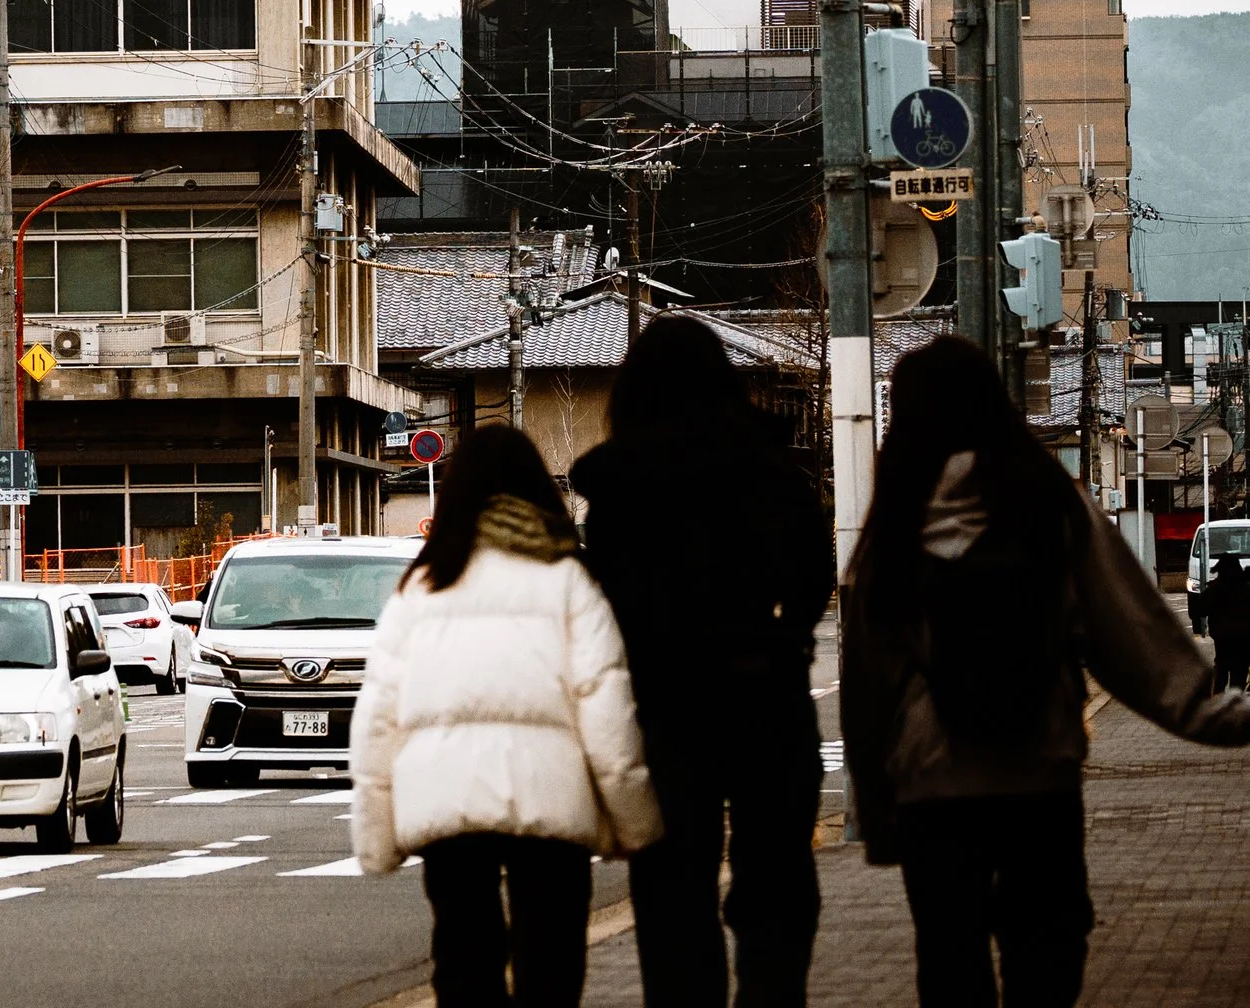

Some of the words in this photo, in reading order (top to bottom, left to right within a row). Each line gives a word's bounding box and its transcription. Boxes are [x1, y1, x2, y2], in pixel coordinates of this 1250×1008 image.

[895, 176, 969, 196] 自転車通行可
[293, 721, 327, 734] 77-88
